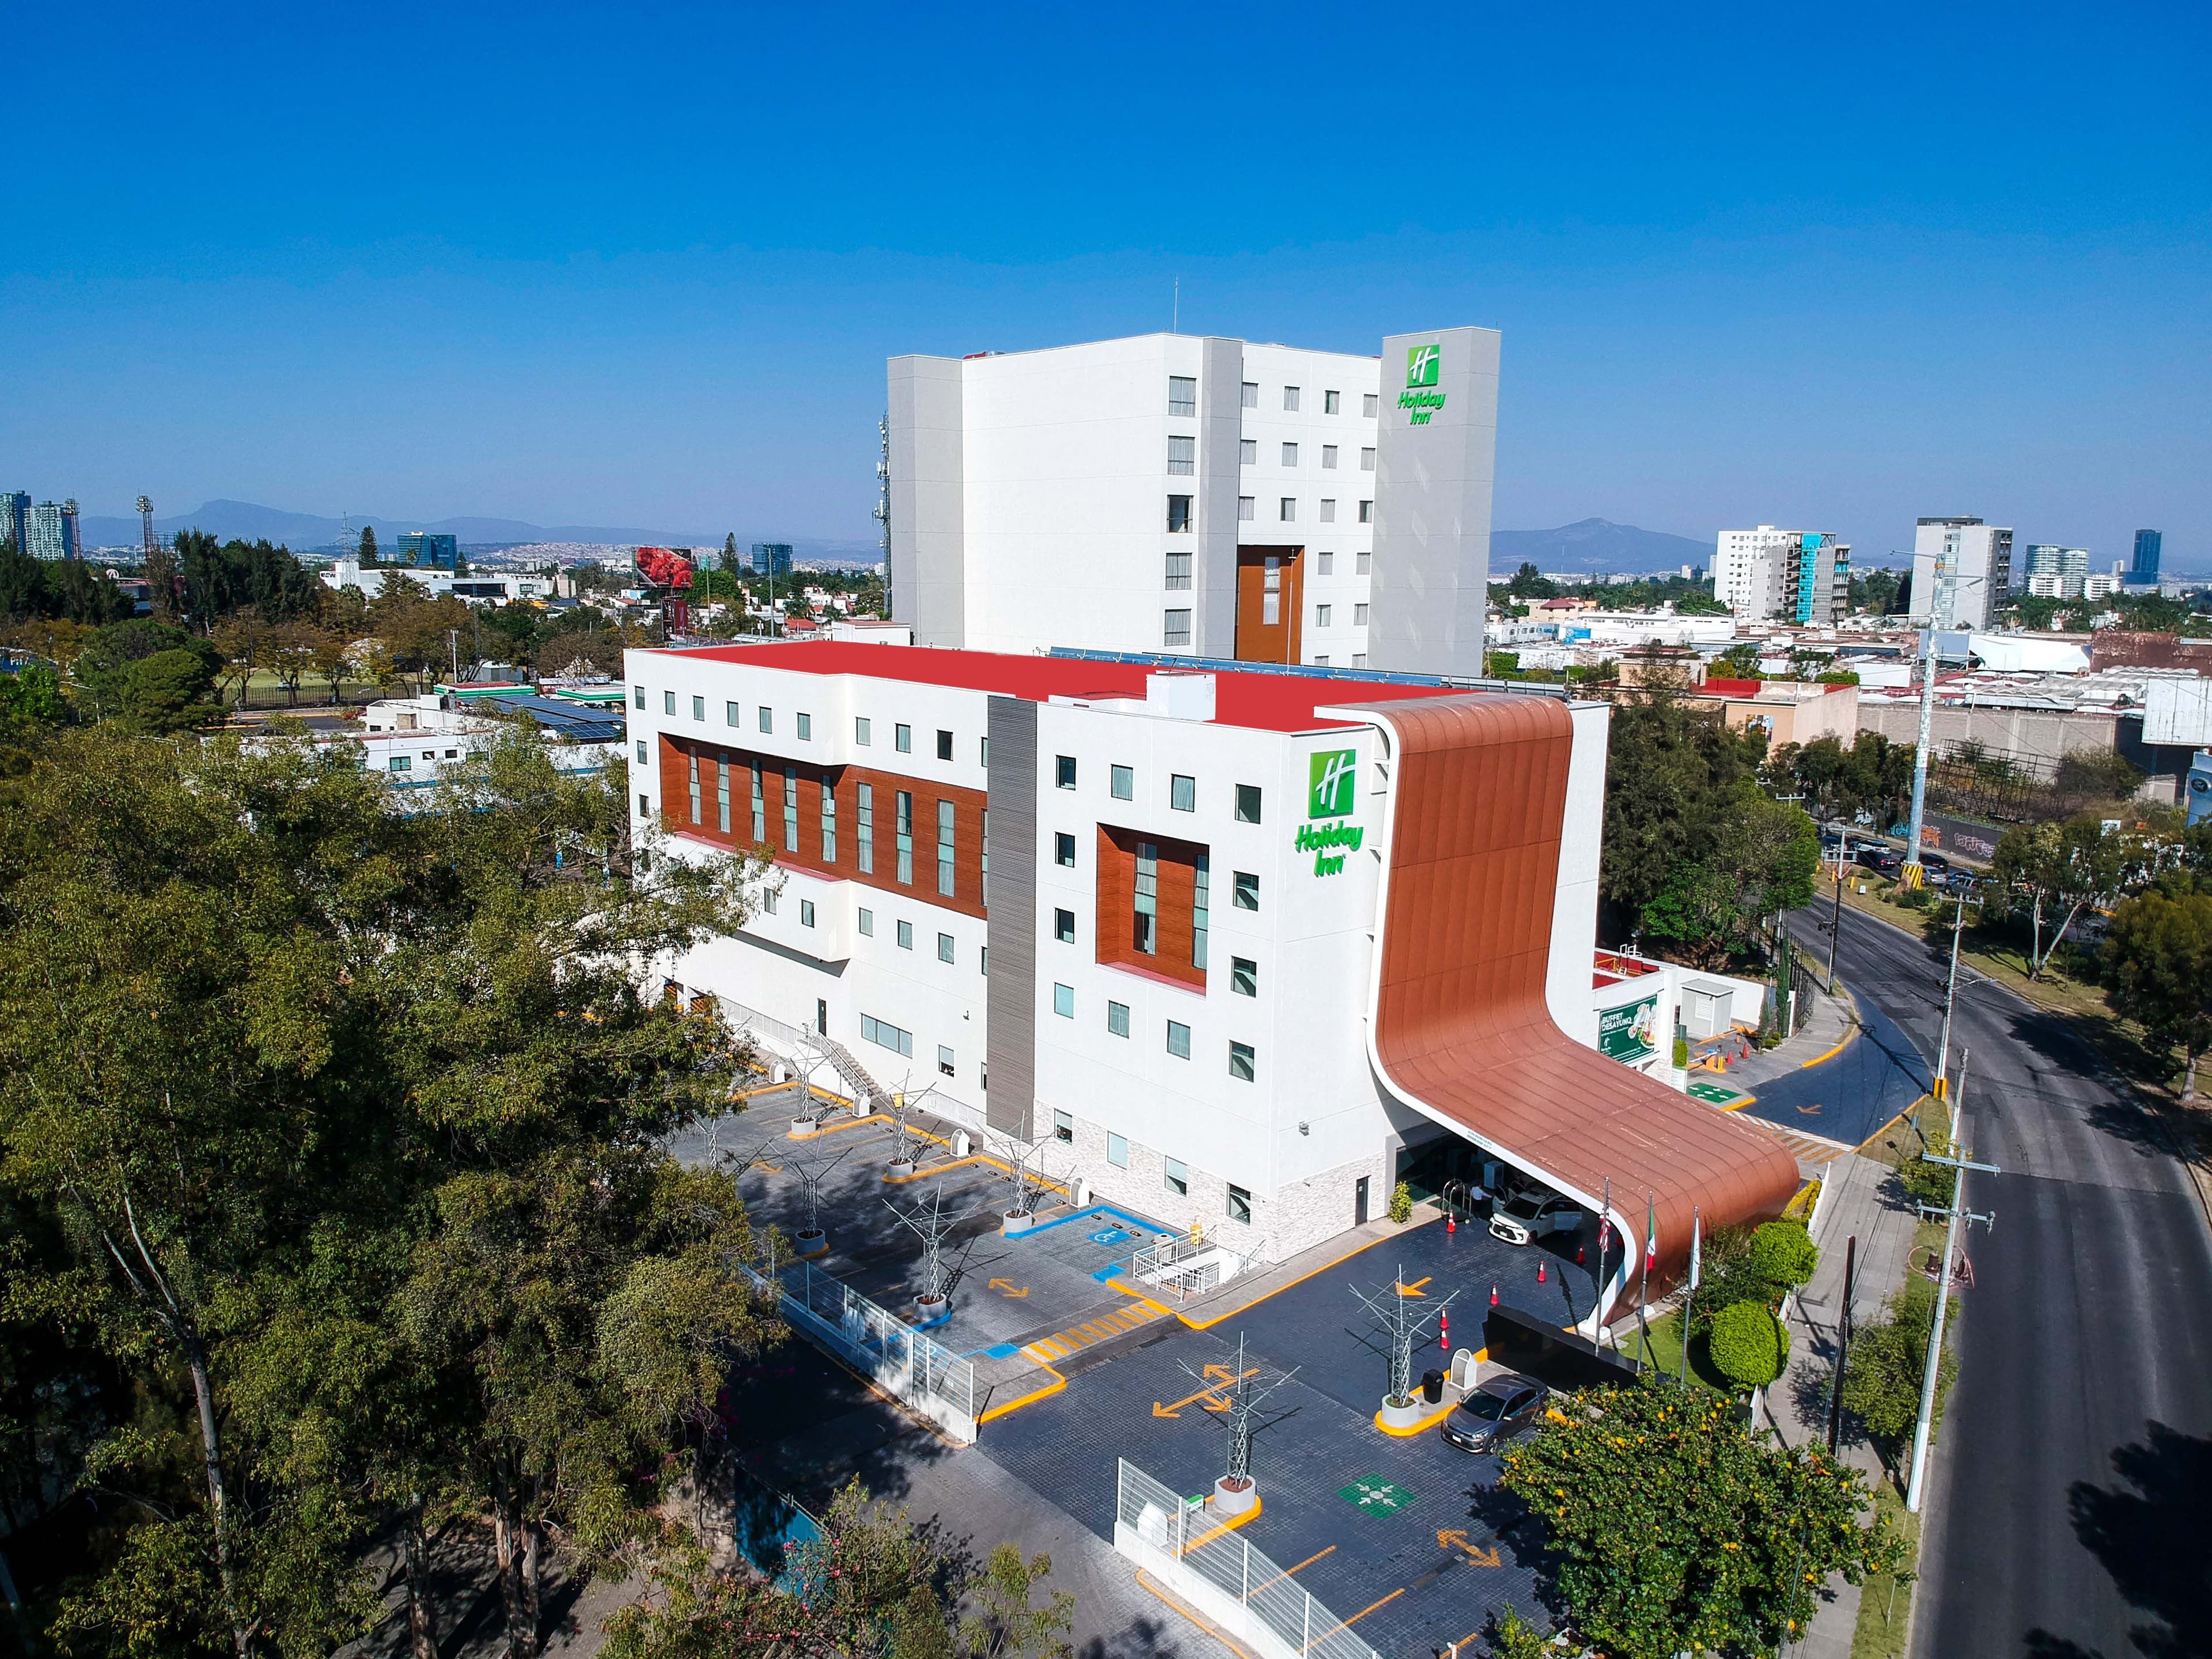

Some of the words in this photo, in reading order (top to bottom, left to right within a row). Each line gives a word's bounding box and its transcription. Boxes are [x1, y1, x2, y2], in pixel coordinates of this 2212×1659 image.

[1397, 391, 1446, 410] Holiday
[1410, 408, 1431, 425] Inn
[1294, 820, 1363, 853] Holiday
[1314, 850, 1345, 877] Inn
[1601, 1017, 1632, 1031] DESAYUNO
[1602, 1012, 1623, 1024] BUFFET
